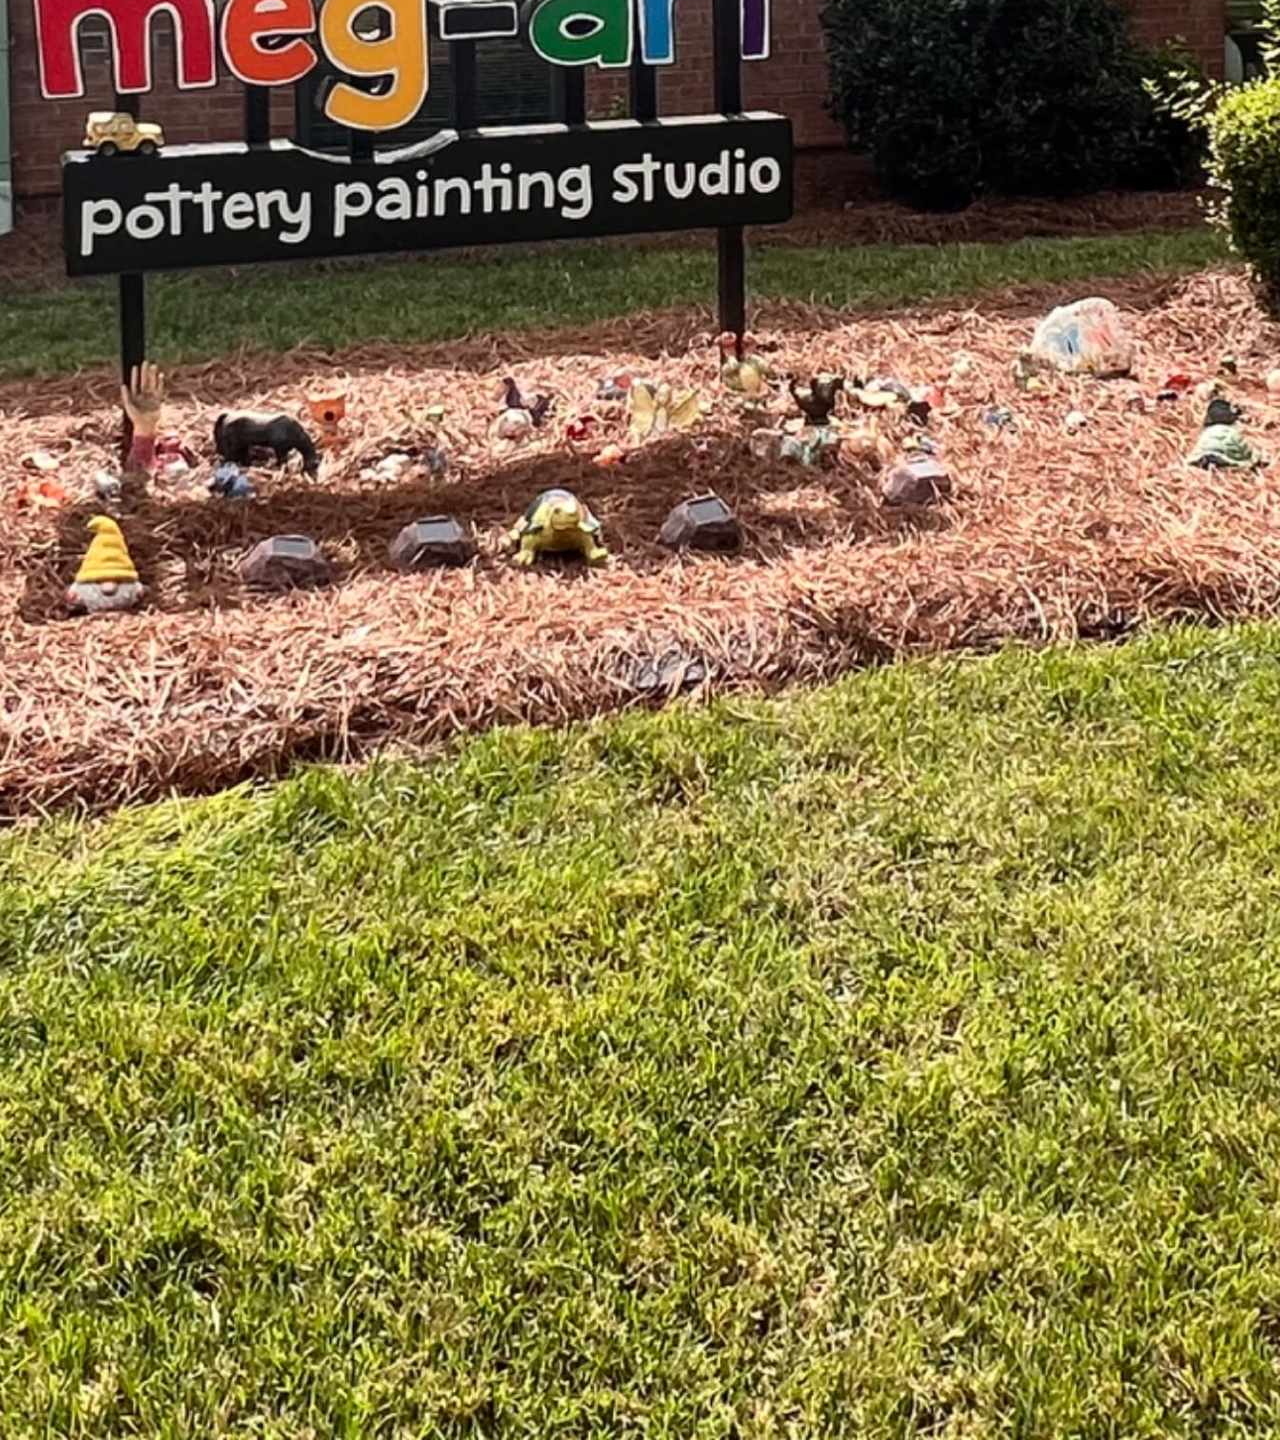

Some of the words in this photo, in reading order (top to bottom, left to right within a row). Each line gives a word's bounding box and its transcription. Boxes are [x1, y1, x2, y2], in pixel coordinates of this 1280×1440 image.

[79, 181, 312, 257] pottery
[333, 161, 593, 237] painting
[612, 147, 782, 204] studio
